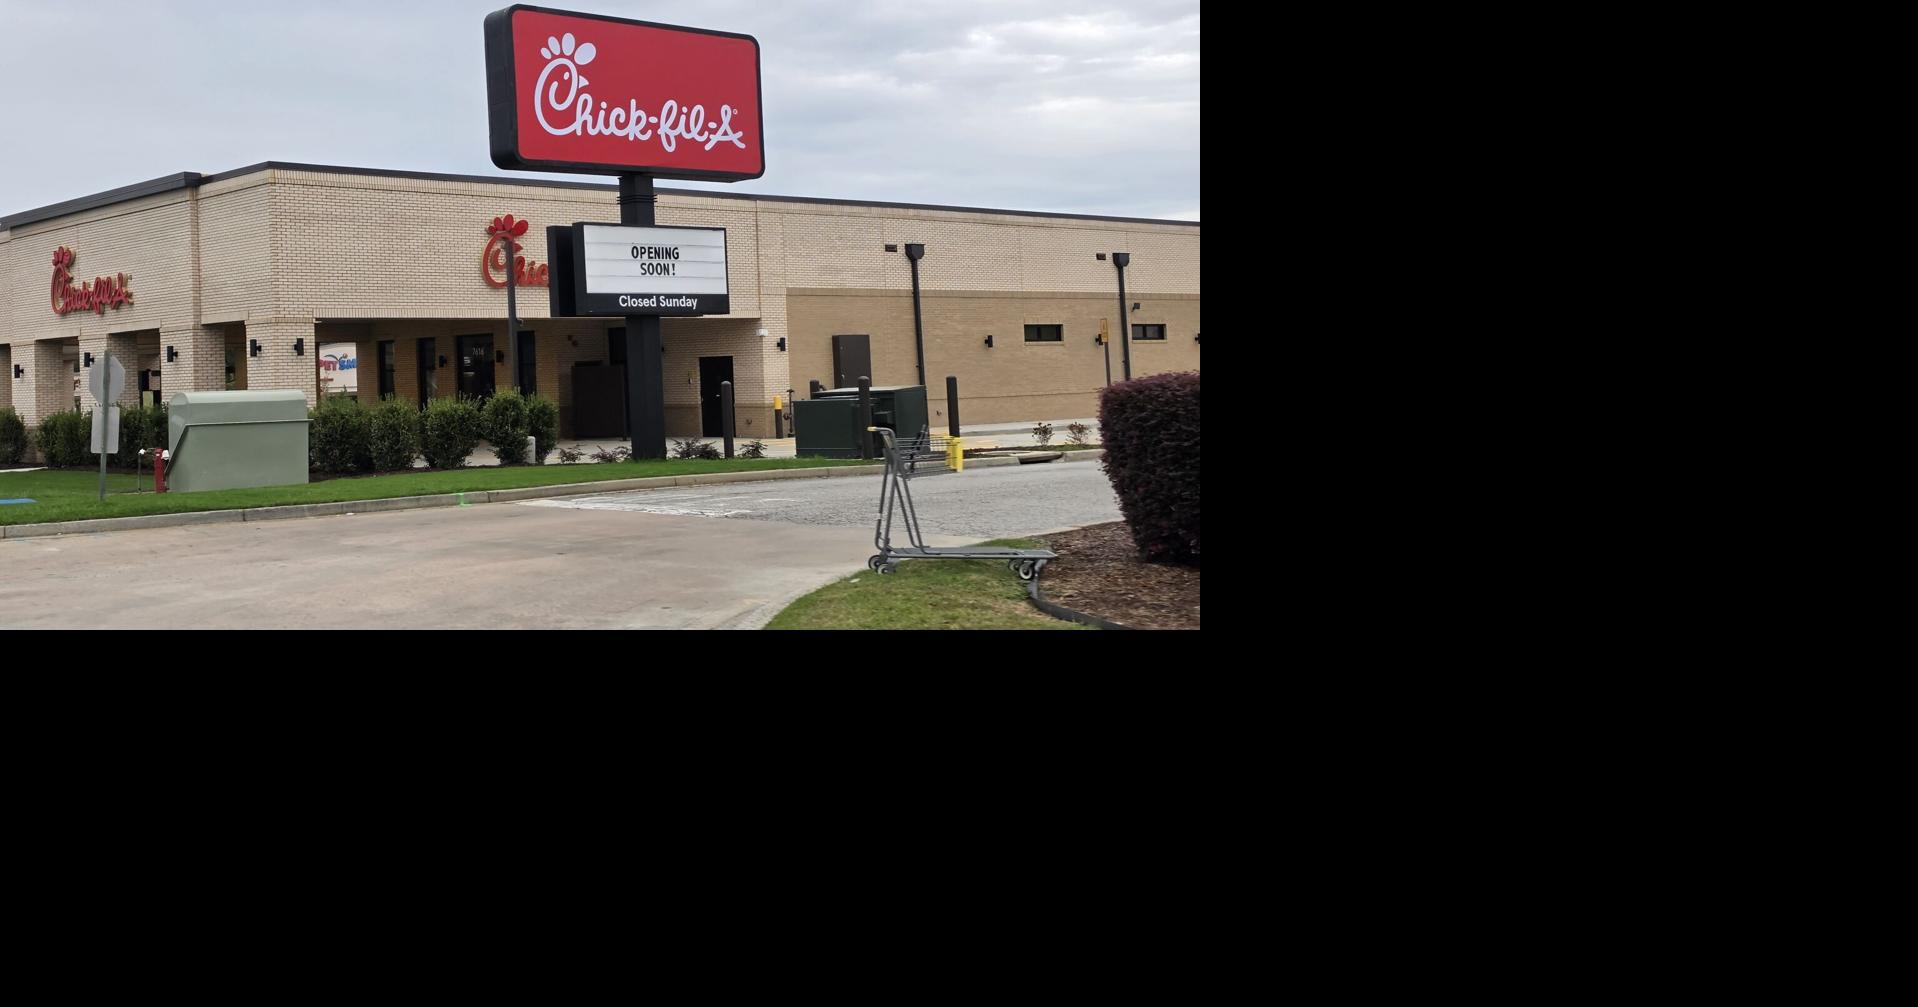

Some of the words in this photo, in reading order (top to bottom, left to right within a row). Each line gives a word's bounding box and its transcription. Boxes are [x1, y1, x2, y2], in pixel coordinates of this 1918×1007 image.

[534, 57, 746, 152] Chick-fil-A
[631, 246, 680, 260] OPENING
[640, 262, 676, 276] SOON!
[618, 295, 657, 307] Closed
[660, 295, 698, 310] Sunday
